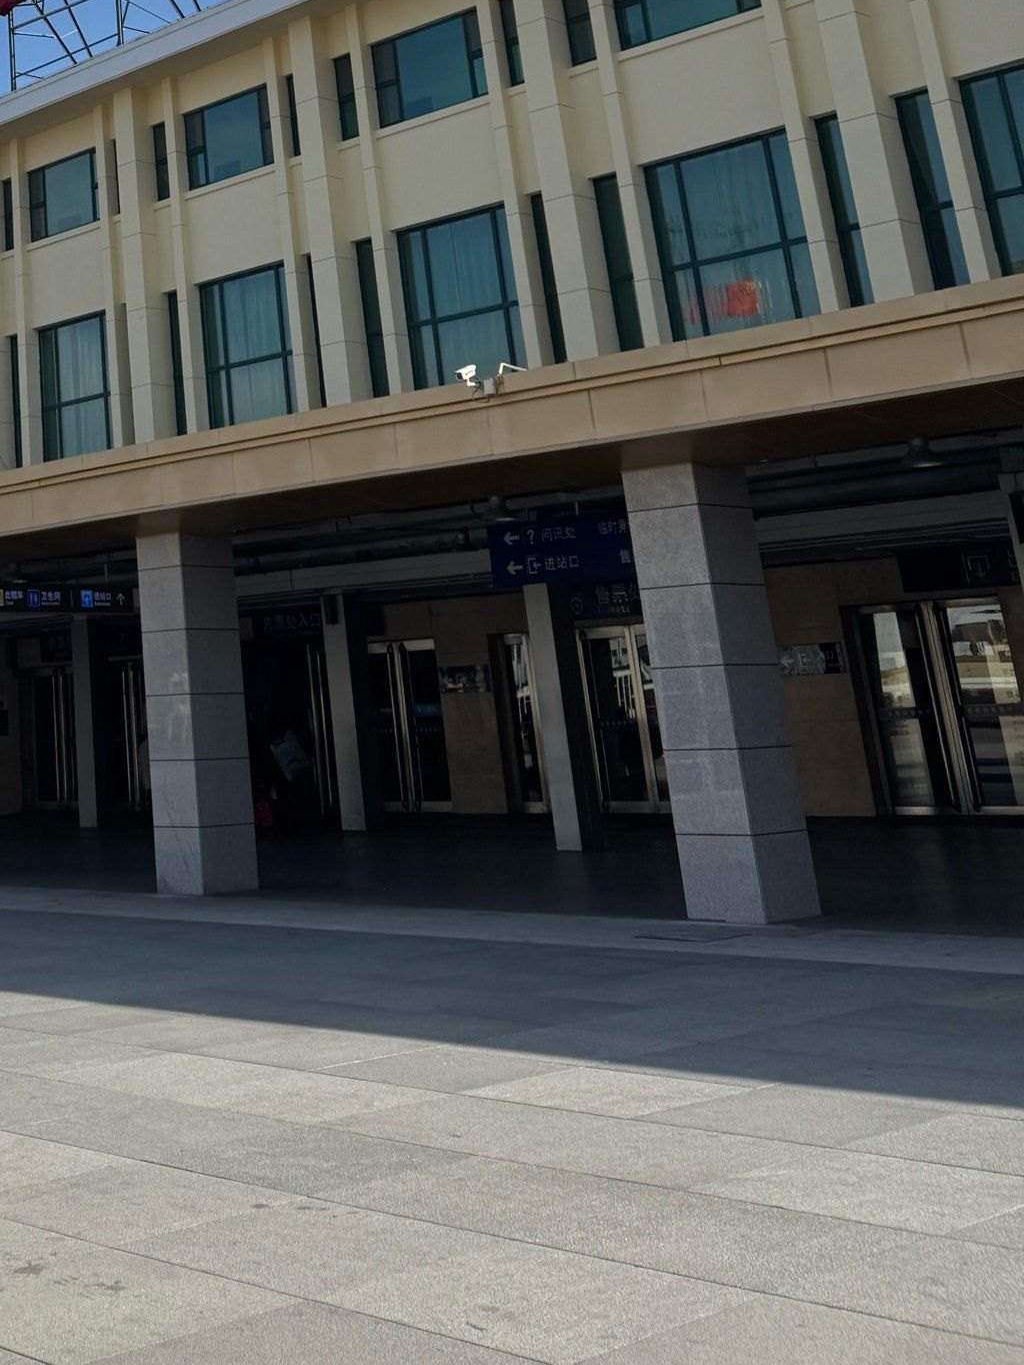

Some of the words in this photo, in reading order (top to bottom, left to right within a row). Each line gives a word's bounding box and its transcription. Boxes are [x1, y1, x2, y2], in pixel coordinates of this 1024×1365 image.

[542, 524, 576, 542] 问讯处
[544, 555, 579, 571] 进站口
[41, 591, 61, 601] 卫生间
